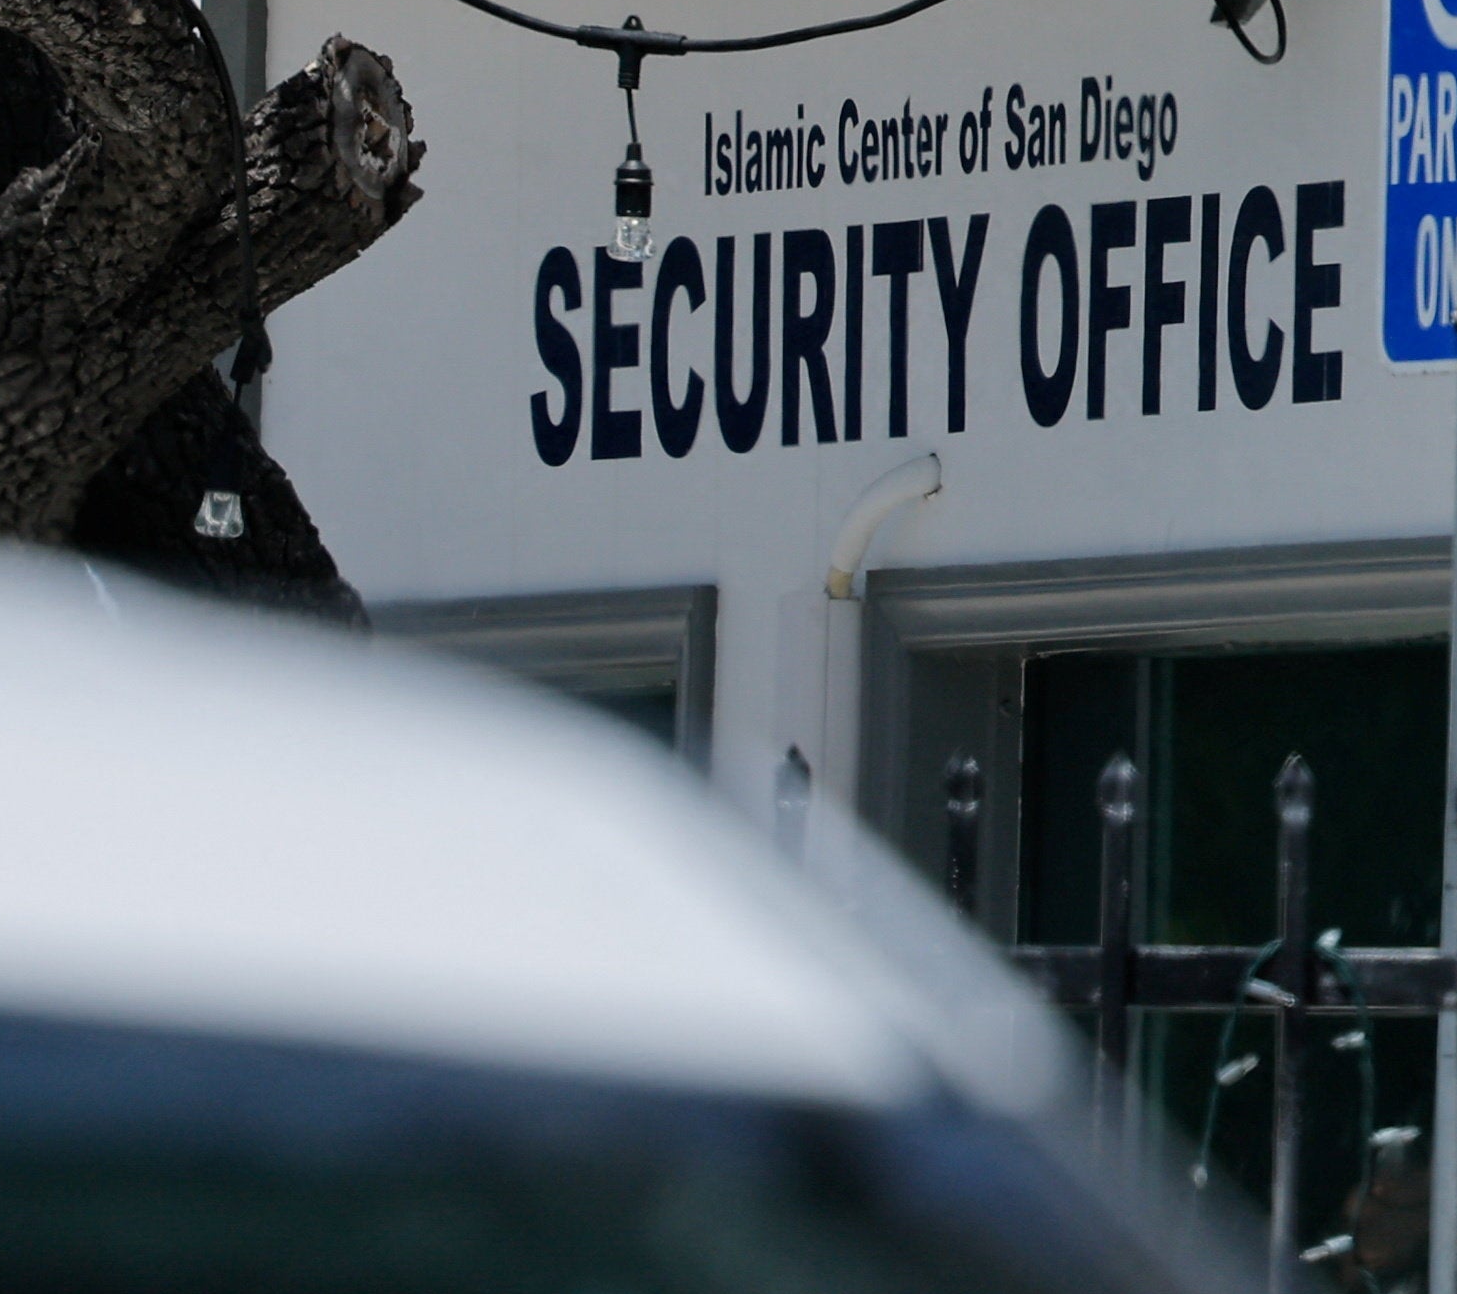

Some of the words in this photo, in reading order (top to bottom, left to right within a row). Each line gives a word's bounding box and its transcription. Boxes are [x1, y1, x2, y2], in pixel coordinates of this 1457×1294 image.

[704, 103, 826, 196] Islamic
[838, 95, 948, 185] Center
[958, 85, 993, 175] of
[1004, 83, 1067, 171] San
[1080, 74, 1178, 182] Diego
[530, 213, 991, 468] SECURITY
[1020, 179, 1345, 427] OFFICE
